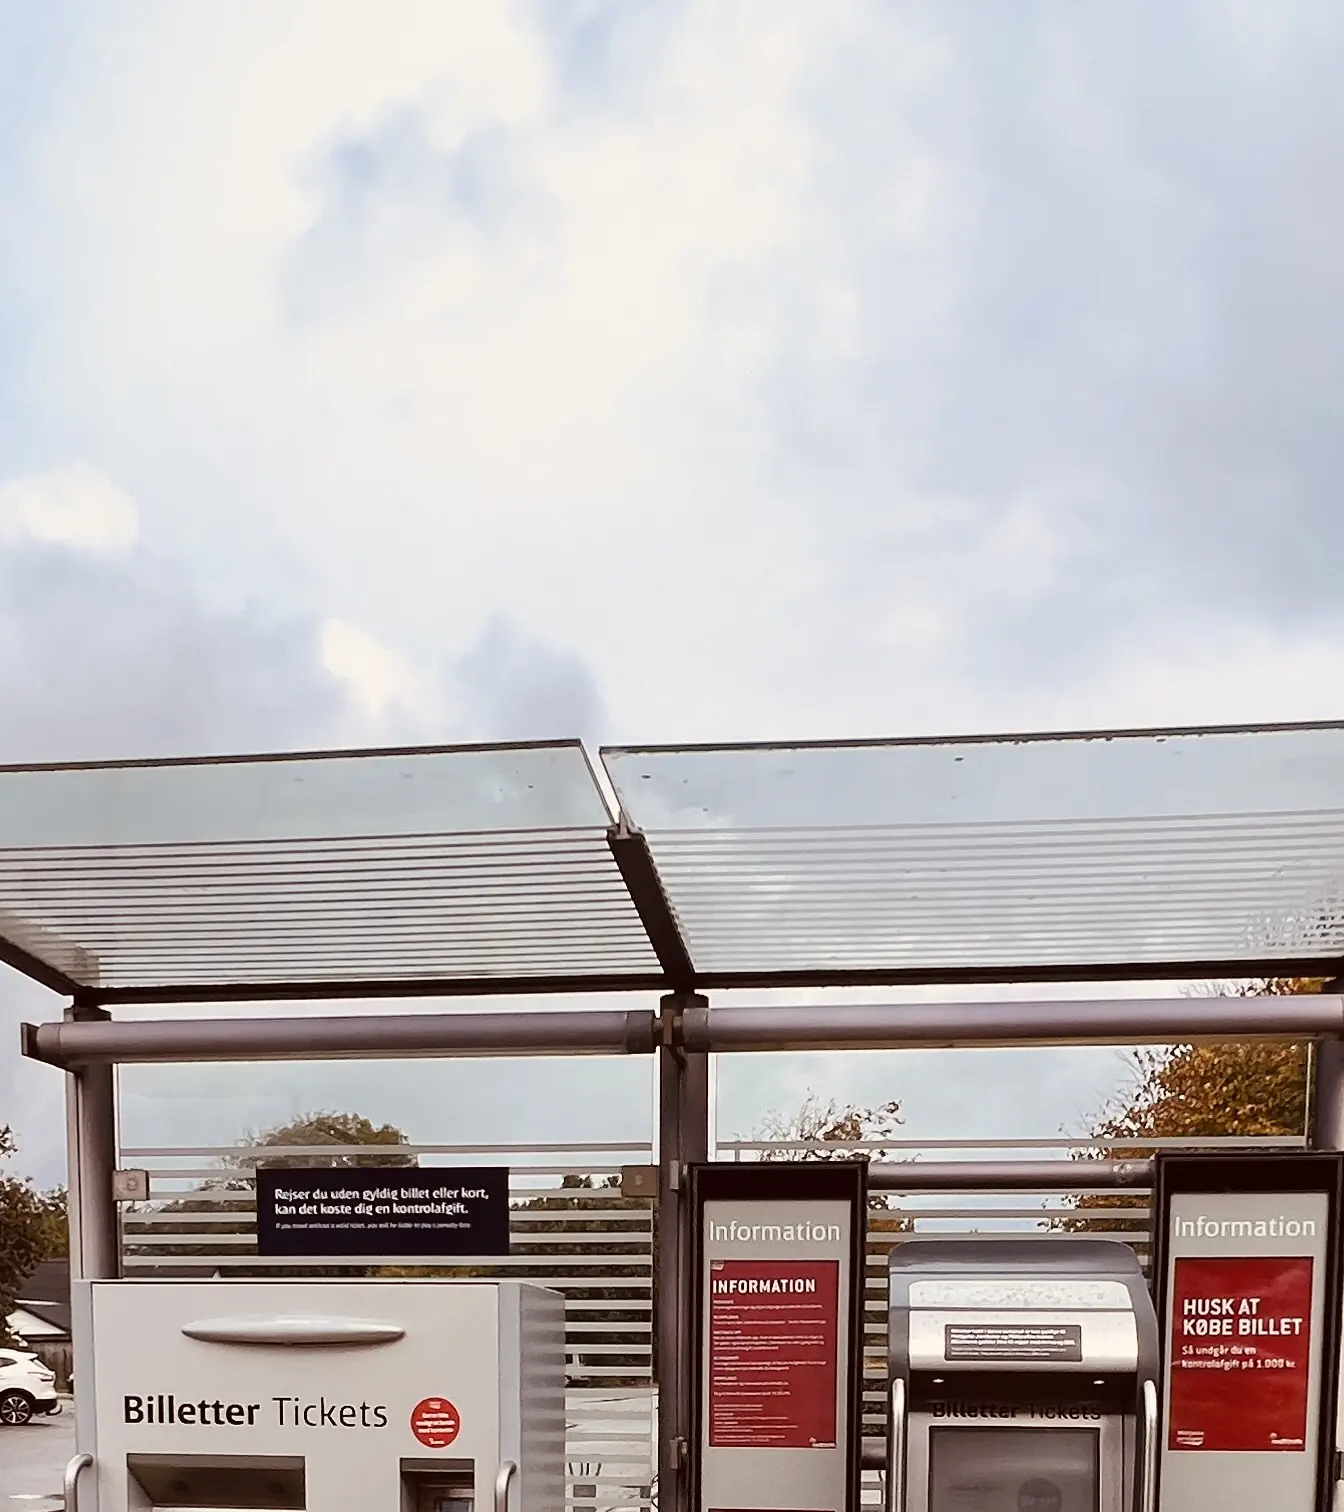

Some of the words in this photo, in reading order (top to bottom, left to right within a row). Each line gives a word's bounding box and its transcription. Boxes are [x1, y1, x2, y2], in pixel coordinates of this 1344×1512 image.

[275, 1188, 310, 1202] Rejser
[312, 1188, 328, 1199] du
[330, 1188, 360, 1200] uden
[362, 1187, 399, 1201] gyldig
[400, 1187, 430, 1199] billet
[432, 1187, 459, 1199] eller
[461, 1187, 489, 1200] kort,
[274, 1203, 296, 1214] kan
[298, 1203, 318, 1214] det
[320, 1203, 352, 1214] koste
[354, 1202, 373, 1216] dig
[375, 1205, 390, 1214] en
[392, 1202, 469, 1216] kontrolafgift.
[709, 1220, 840, 1241] Information
[1175, 1216, 1316, 1237] Information
[712, 1279, 816, 1294] INFORMATION
[1183, 1298, 1235, 1315] HUSK
[1238, 1298, 1261, 1315] AT
[1183, 1318, 1233, 1336] KØBE
[1238, 1318, 1303, 1335] BILLET
[1181, 1345, 1193, 1355] Så
[1196, 1344, 1229, 1358] undgår
[1230, 1345, 1242, 1355] du
[1244, 1347, 1256, 1355] en
[1181, 1358, 1240, 1371] kontrolafgift
[1241, 1358, 1254, 1370] på
[124, 1395, 260, 1426] Billetter
[272, 1397, 388, 1428] Tickets
[932, 1402, 1018, 1419] Billetter
[1028, 1403, 1101, 1420] Tickets
